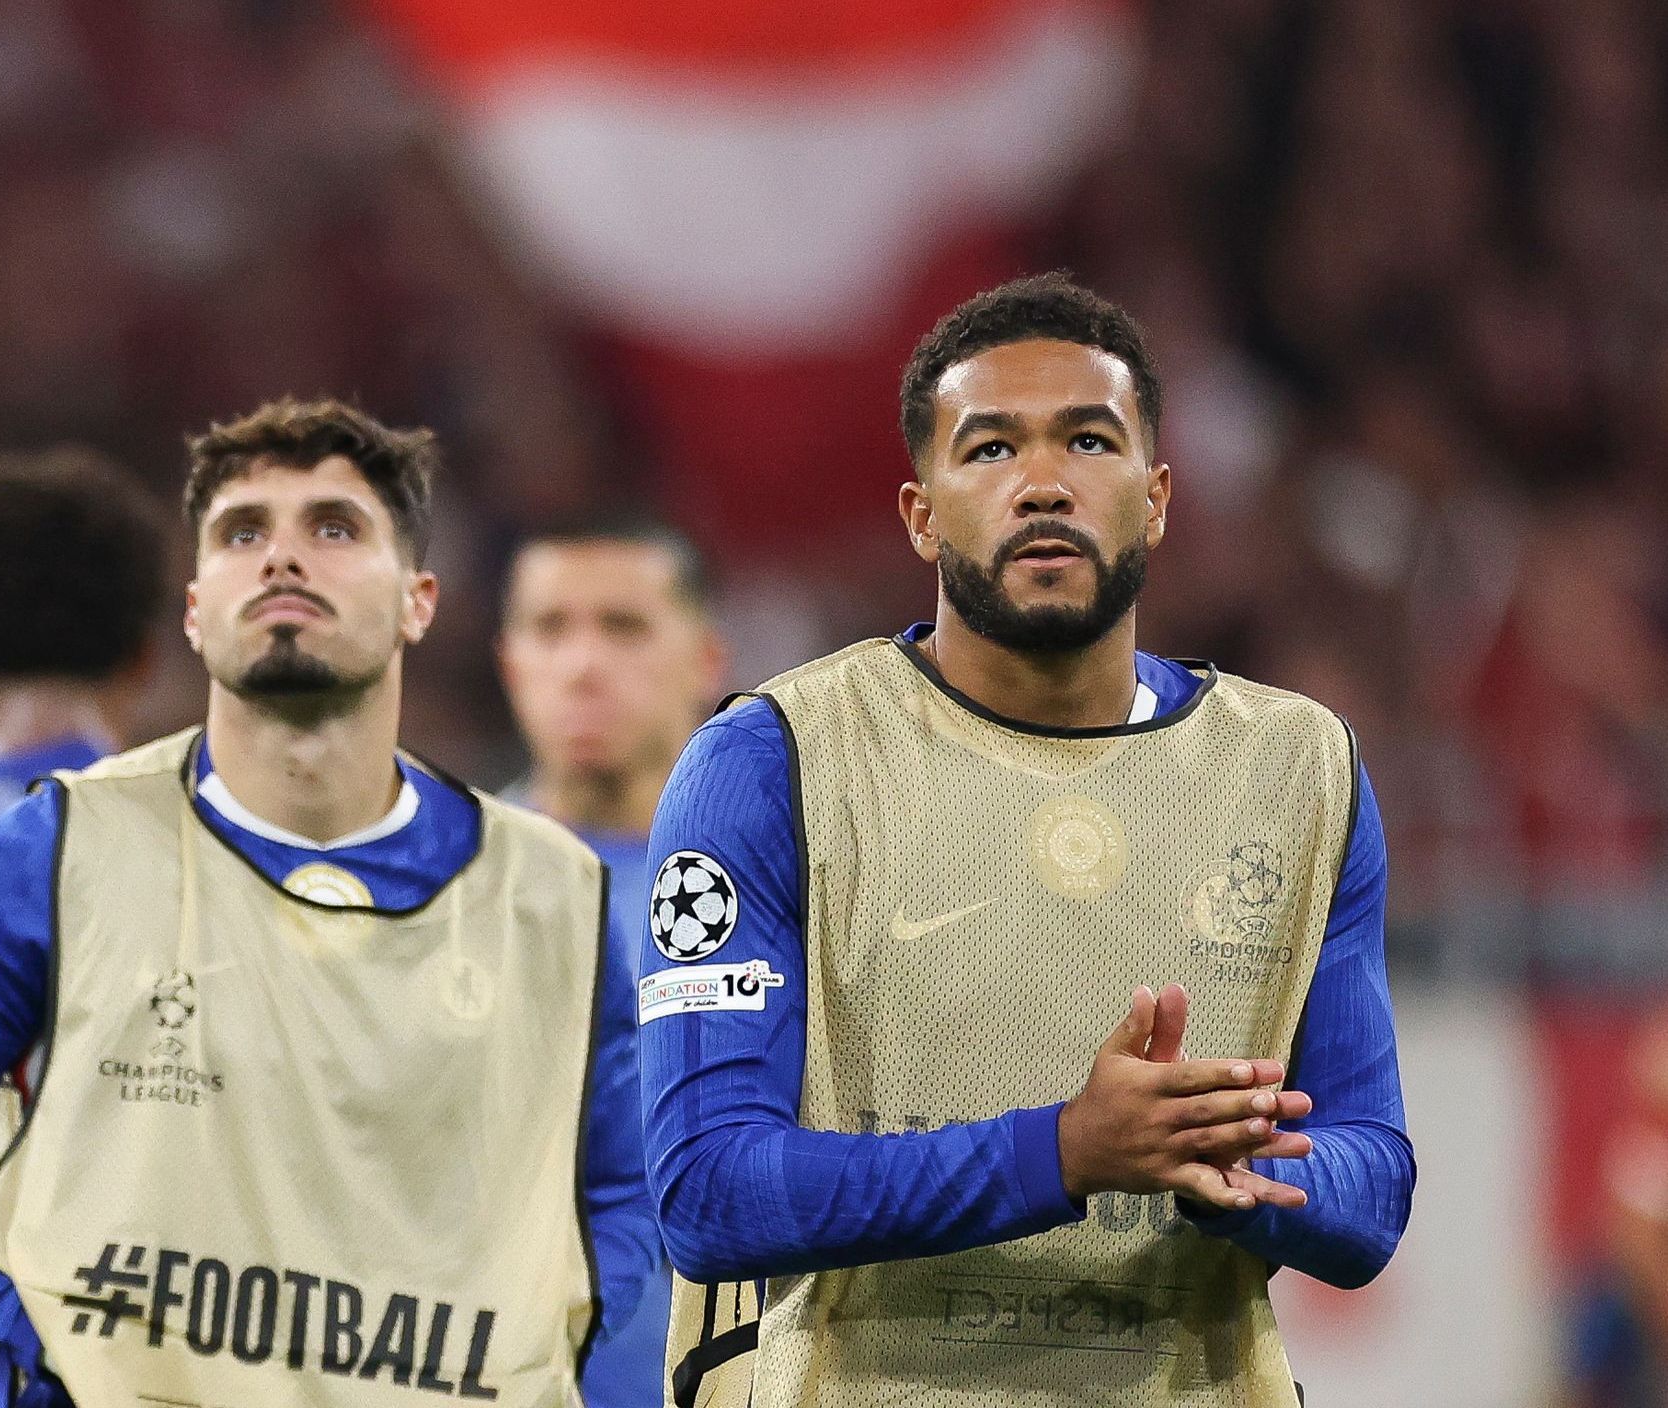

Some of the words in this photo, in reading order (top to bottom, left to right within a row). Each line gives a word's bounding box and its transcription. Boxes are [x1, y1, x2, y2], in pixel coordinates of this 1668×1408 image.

[641, 983, 718, 1007] FOUNDATION
[722, 974, 760, 996] 10
[64, 1243, 499, 1400] #FOOTBALL
